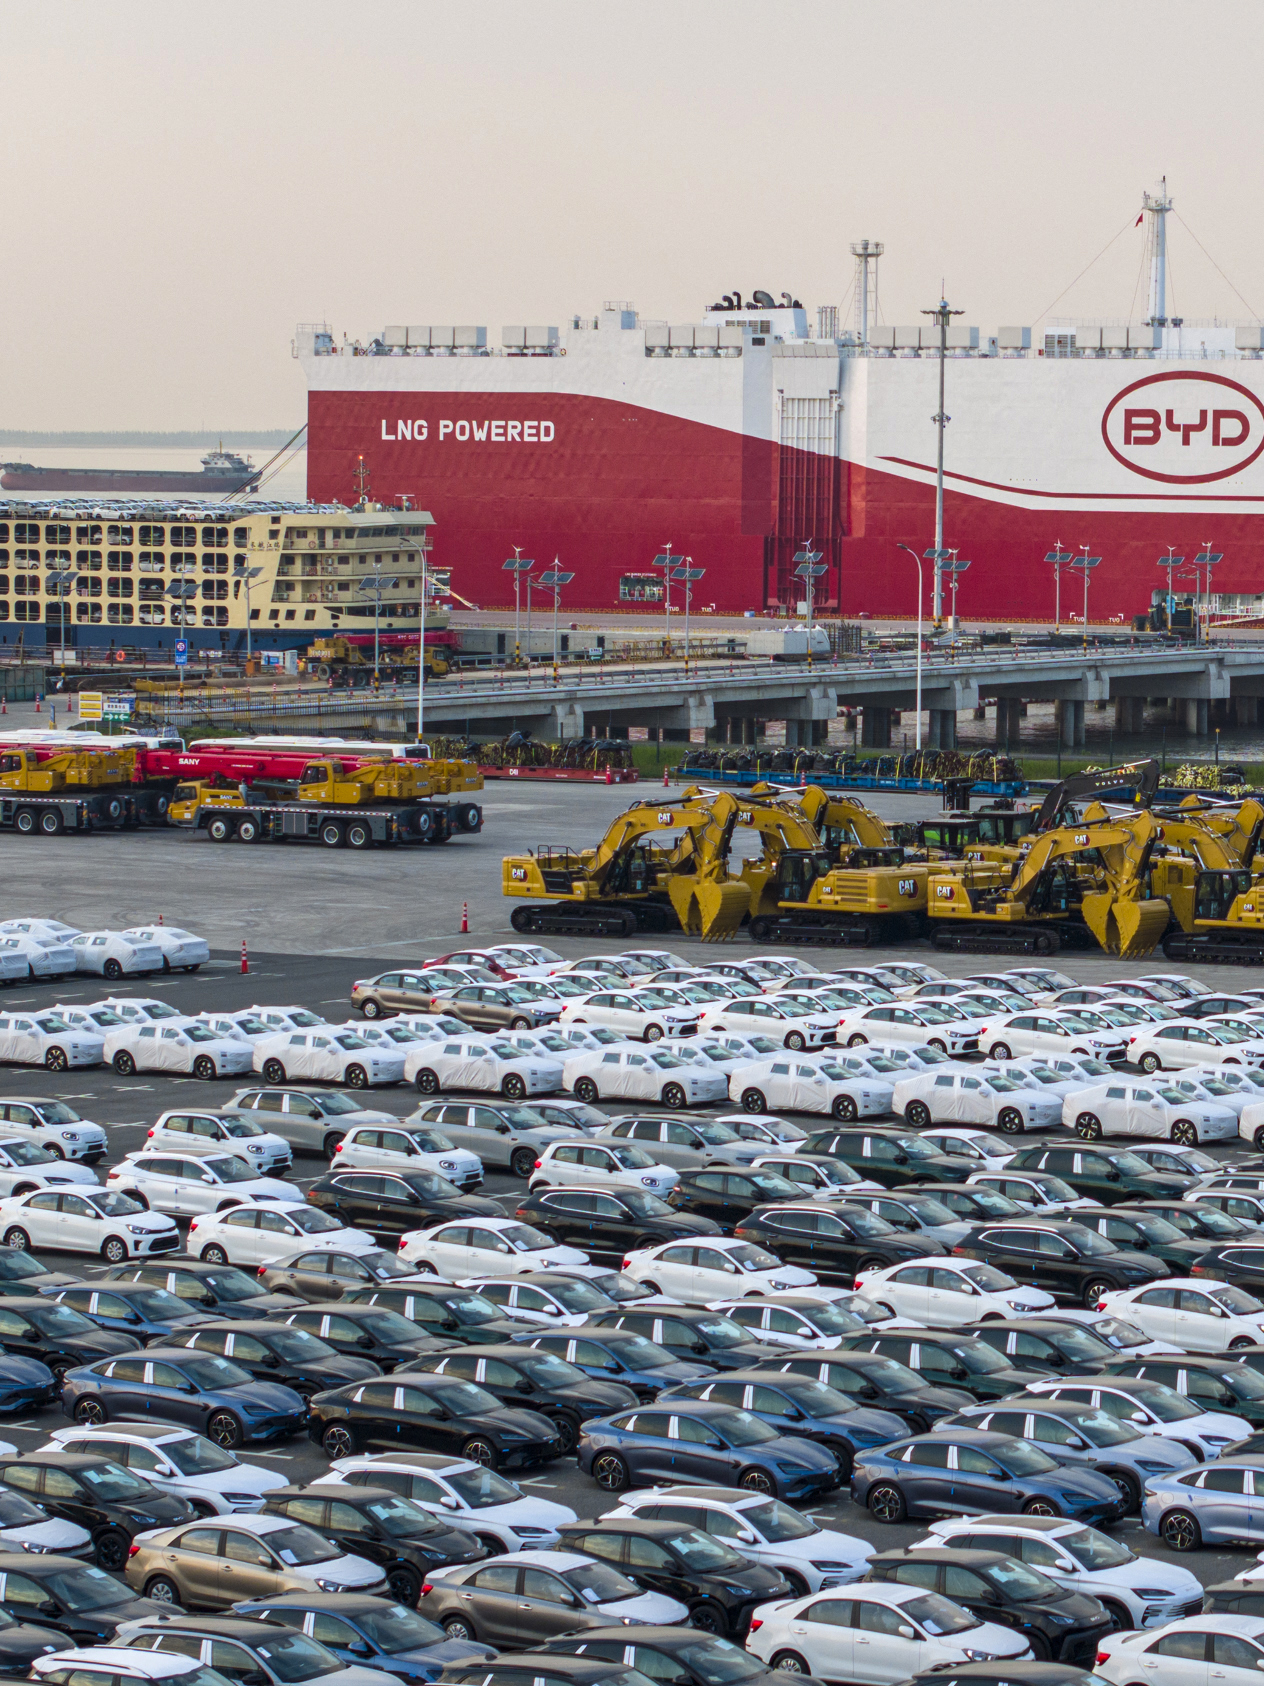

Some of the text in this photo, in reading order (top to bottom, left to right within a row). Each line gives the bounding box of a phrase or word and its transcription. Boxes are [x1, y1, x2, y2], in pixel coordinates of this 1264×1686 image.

[381, 419, 555, 443] LNG POWERED
[1123, 408, 1250, 446] BYD
[1095, 779, 1124, 787] VOLVO
[658, 813, 671, 824] CAT
[738, 812, 751, 822] CAT
[1075, 835, 1086, 845] CAT
[512, 869, 524, 879] CAT
[899, 879, 914, 894] CAT
[937, 886, 951, 897] CAT
